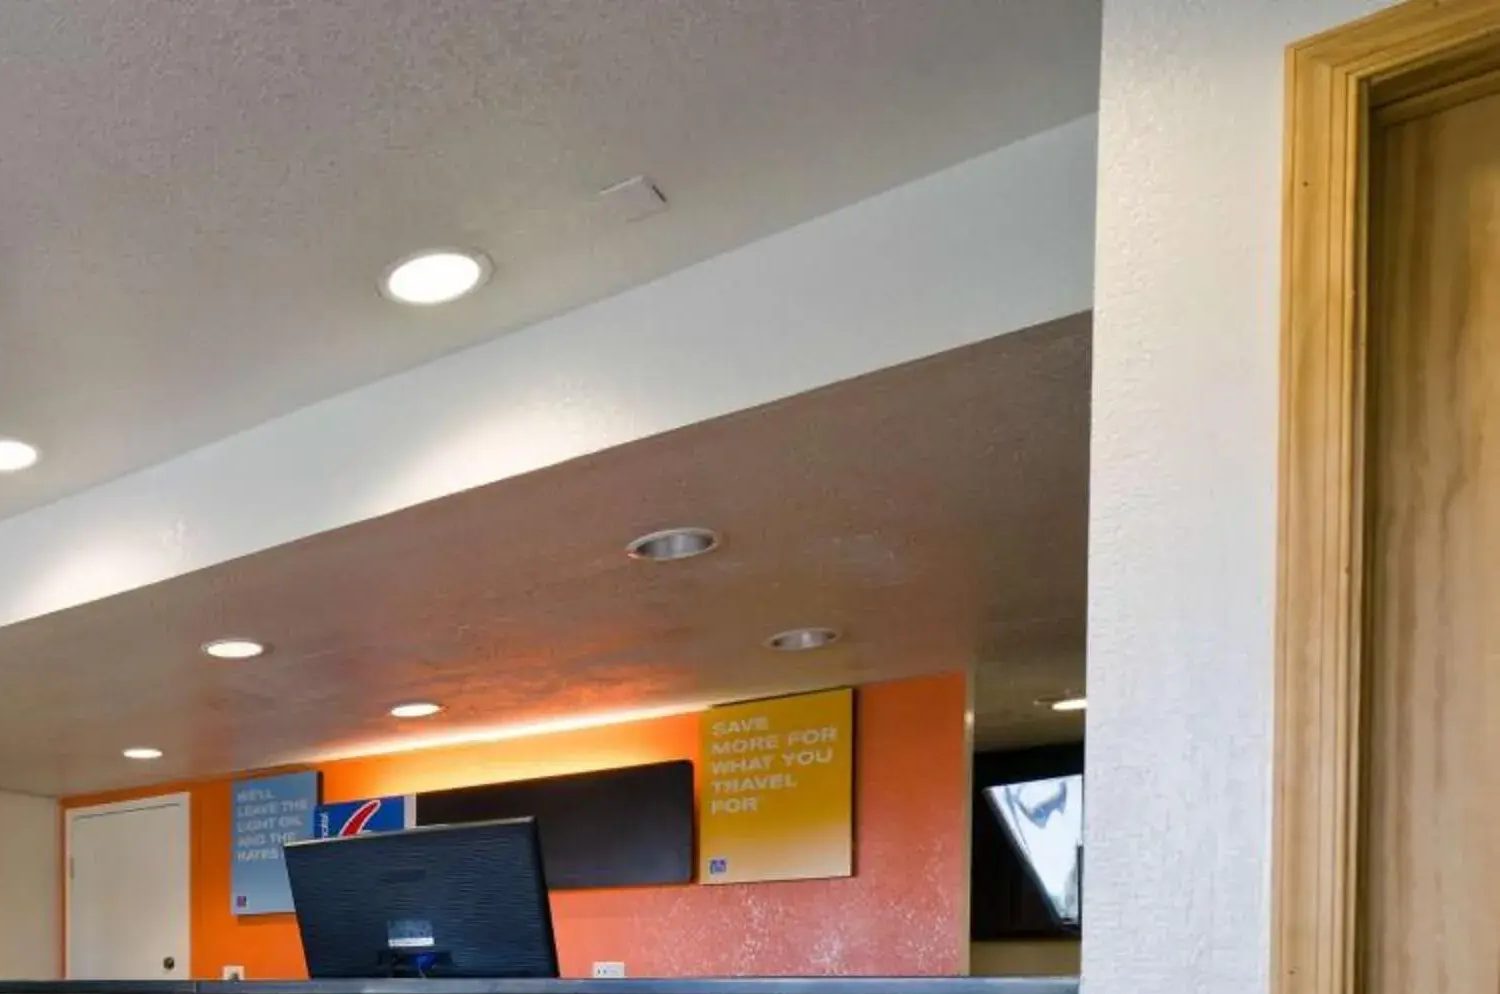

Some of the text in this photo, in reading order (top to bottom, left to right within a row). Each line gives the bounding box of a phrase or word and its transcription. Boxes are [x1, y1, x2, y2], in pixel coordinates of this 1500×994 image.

[712, 716, 769, 736] SAVE
[712, 726, 838, 755] MORE FOR
[712, 747, 833, 776] WHAT YOU
[712, 774, 797, 794] TRAVEL
[238, 799, 308, 817] LEAVE THE
[238, 817, 277, 832] LIGHT
